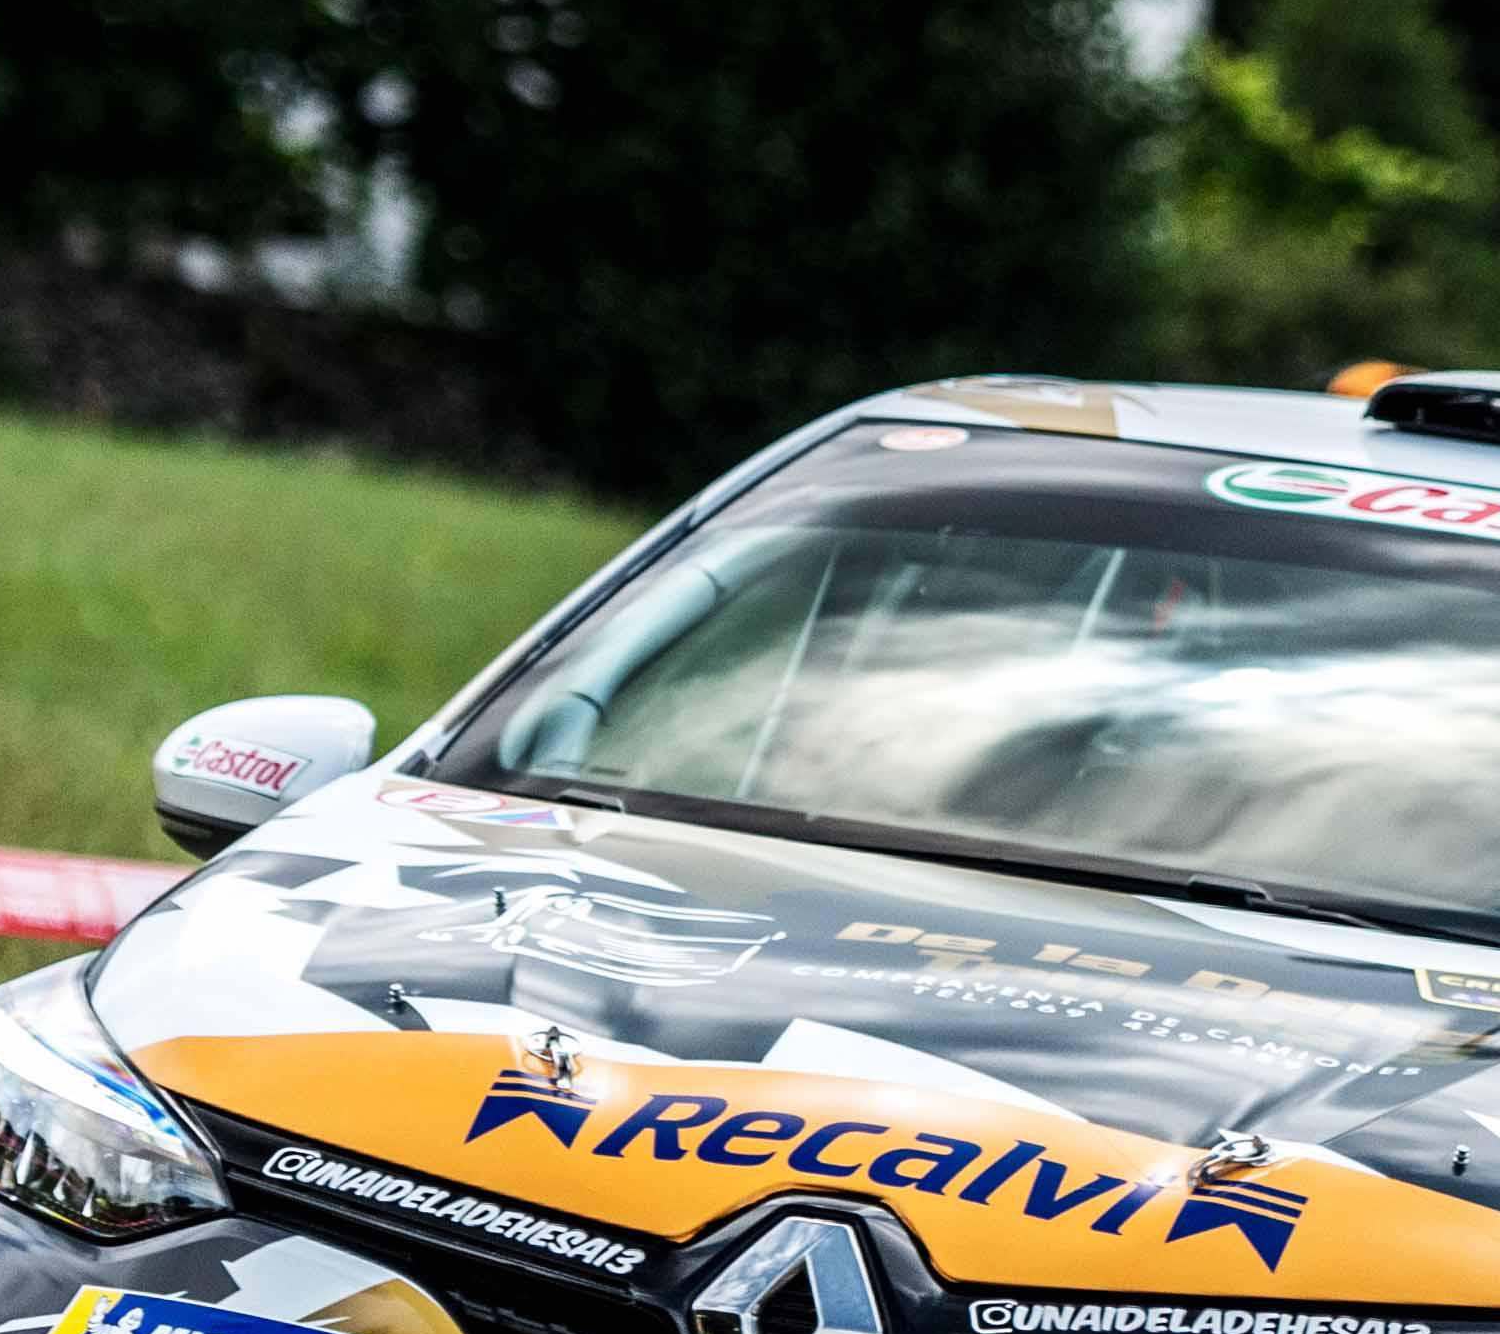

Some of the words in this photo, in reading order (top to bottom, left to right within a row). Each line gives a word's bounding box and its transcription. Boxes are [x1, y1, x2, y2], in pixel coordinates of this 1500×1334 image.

[193, 740, 298, 791] Castrol
[835, 921, 998, 954] De
[790, 964, 1103, 1012] COMPRAVENTA
[1130, 1009, 1181, 1030] DE
[1206, 1028, 1422, 1075] CAMIONES
[592, 1093, 1166, 1237] Recalvi
